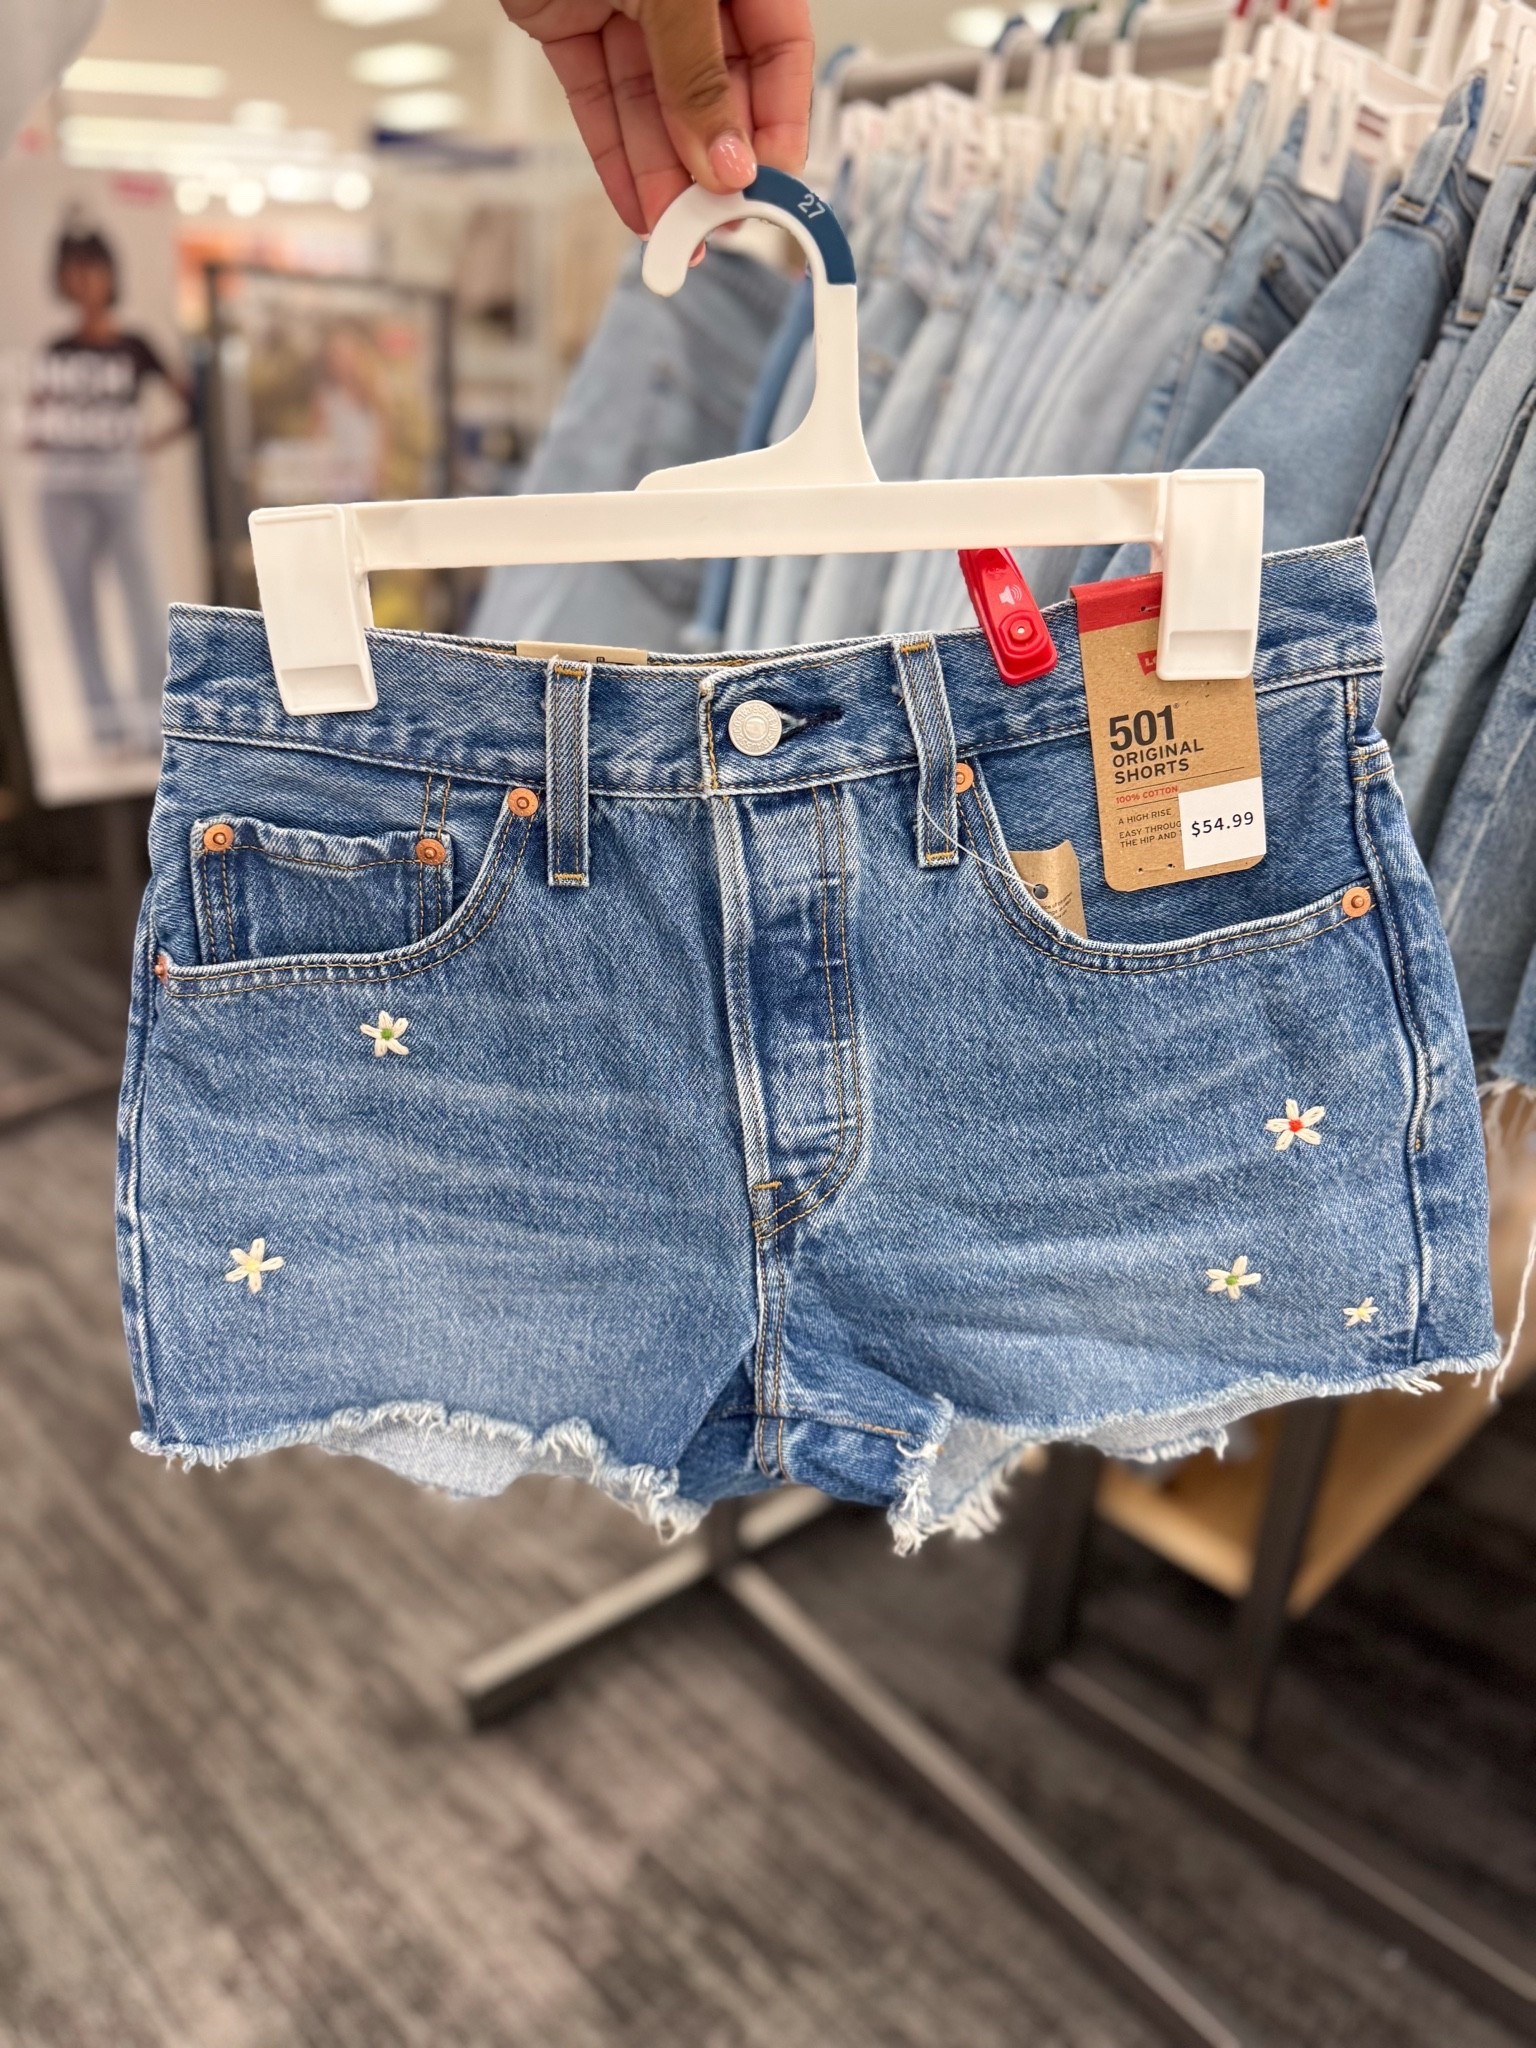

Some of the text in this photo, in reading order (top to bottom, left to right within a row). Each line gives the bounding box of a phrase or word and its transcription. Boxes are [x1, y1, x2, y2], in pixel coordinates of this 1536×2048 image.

[798, 194, 826, 219] 27
[1113, 738, 1204, 767] ORIGINAL
[1114, 758, 1189, 784] SHORTS
[1116, 785, 1178, 804] 100% COTTON
[1118, 808, 1172, 826] A HIGH RISE
[1191, 811, 1254, 838] $54.99
[1119, 820, 1182, 839] EASY THROUG
[1120, 831, 1177, 848] THE HIP AND
